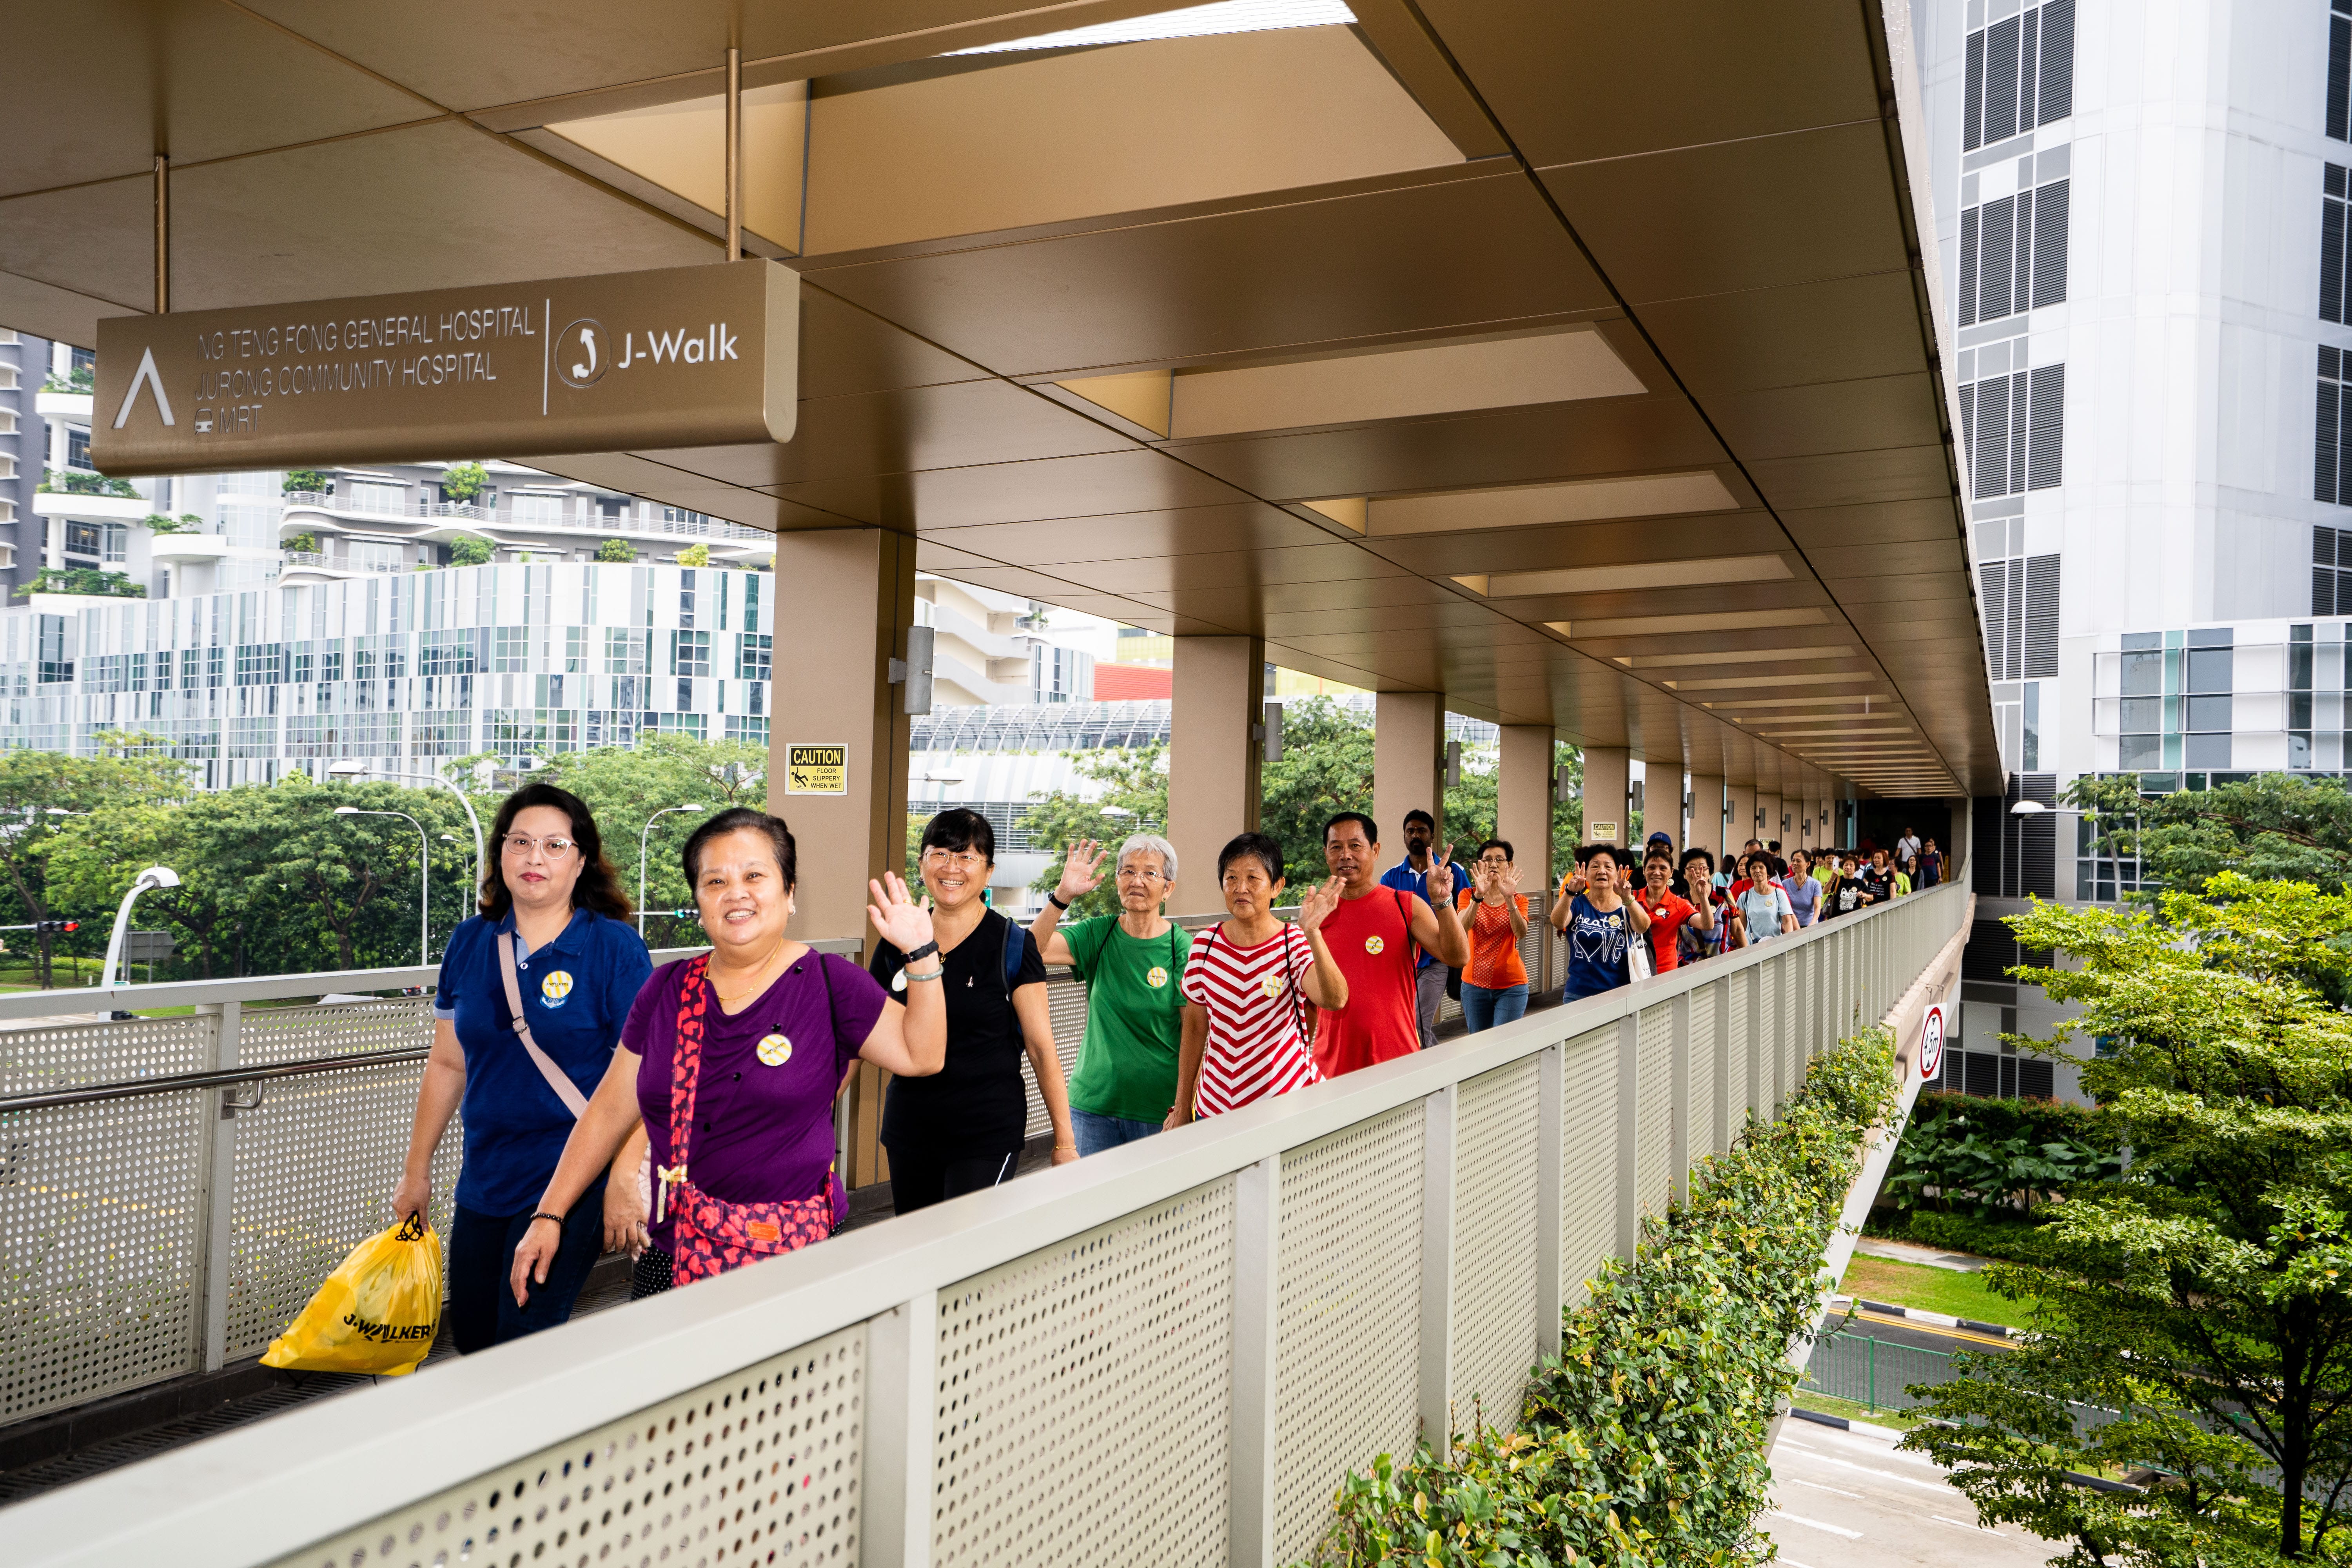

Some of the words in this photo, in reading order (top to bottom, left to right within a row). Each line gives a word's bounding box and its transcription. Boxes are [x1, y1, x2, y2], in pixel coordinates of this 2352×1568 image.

[198, 332, 223, 360] NG
[231, 327, 278, 357] TENG
[286, 322, 337, 353] FONG
[344, 316, 433, 349] GENERAL
[439, 307, 535, 342] HOSPITAL
[618, 323, 738, 369] J-Walk
[195, 368, 272, 400] JURONG
[279, 359, 396, 395] COMMUNITY
[403, 352, 497, 386] HOSPITAL
[219, 405, 262, 434] MRT
[793, 750, 841, 764] CAUTION
[1924, 1031, 1938, 1056] 4.5m
